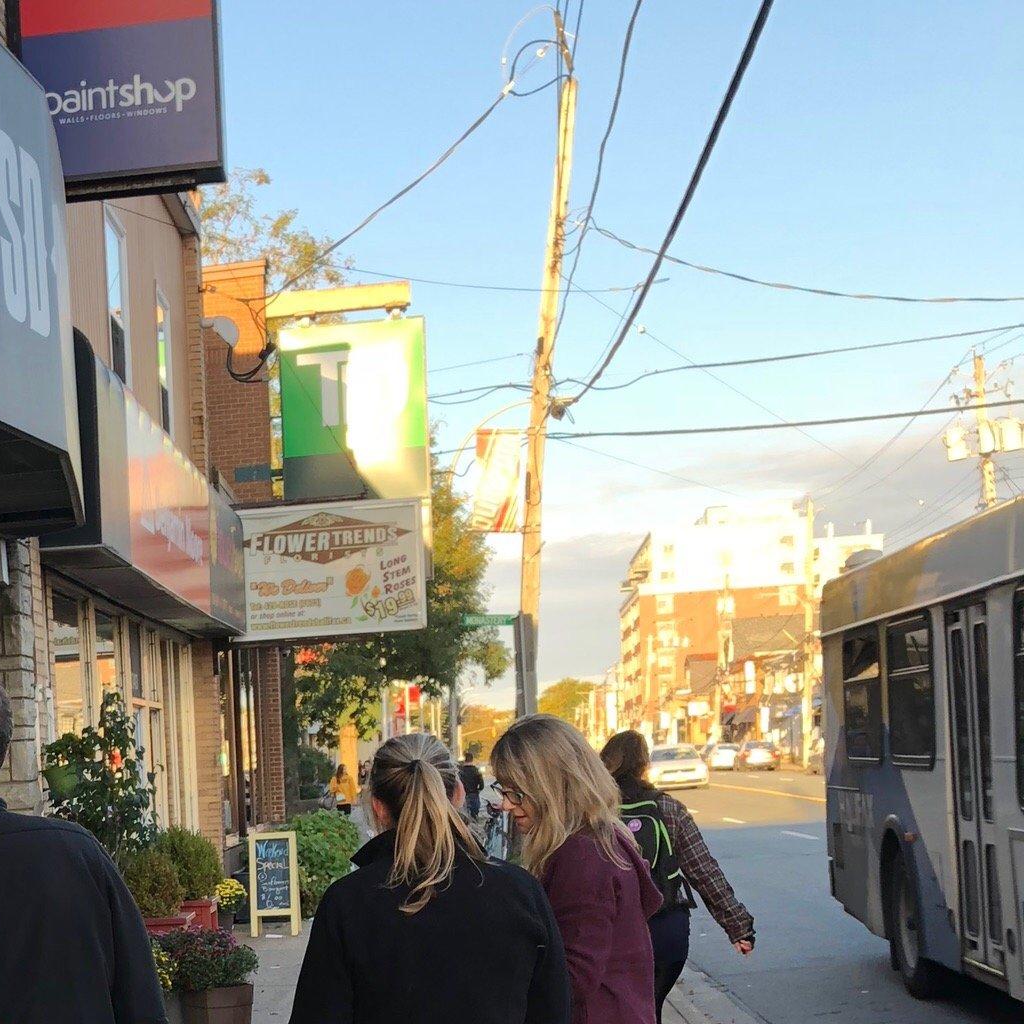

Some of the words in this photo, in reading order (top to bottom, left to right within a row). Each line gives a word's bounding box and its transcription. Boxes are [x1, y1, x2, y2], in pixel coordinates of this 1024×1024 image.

[126, 106, 168, 118] WINDOWS
[379, 554, 407, 571] LONG
[382, 565, 411, 583] STEM
[383, 575, 417, 596] ROSES
